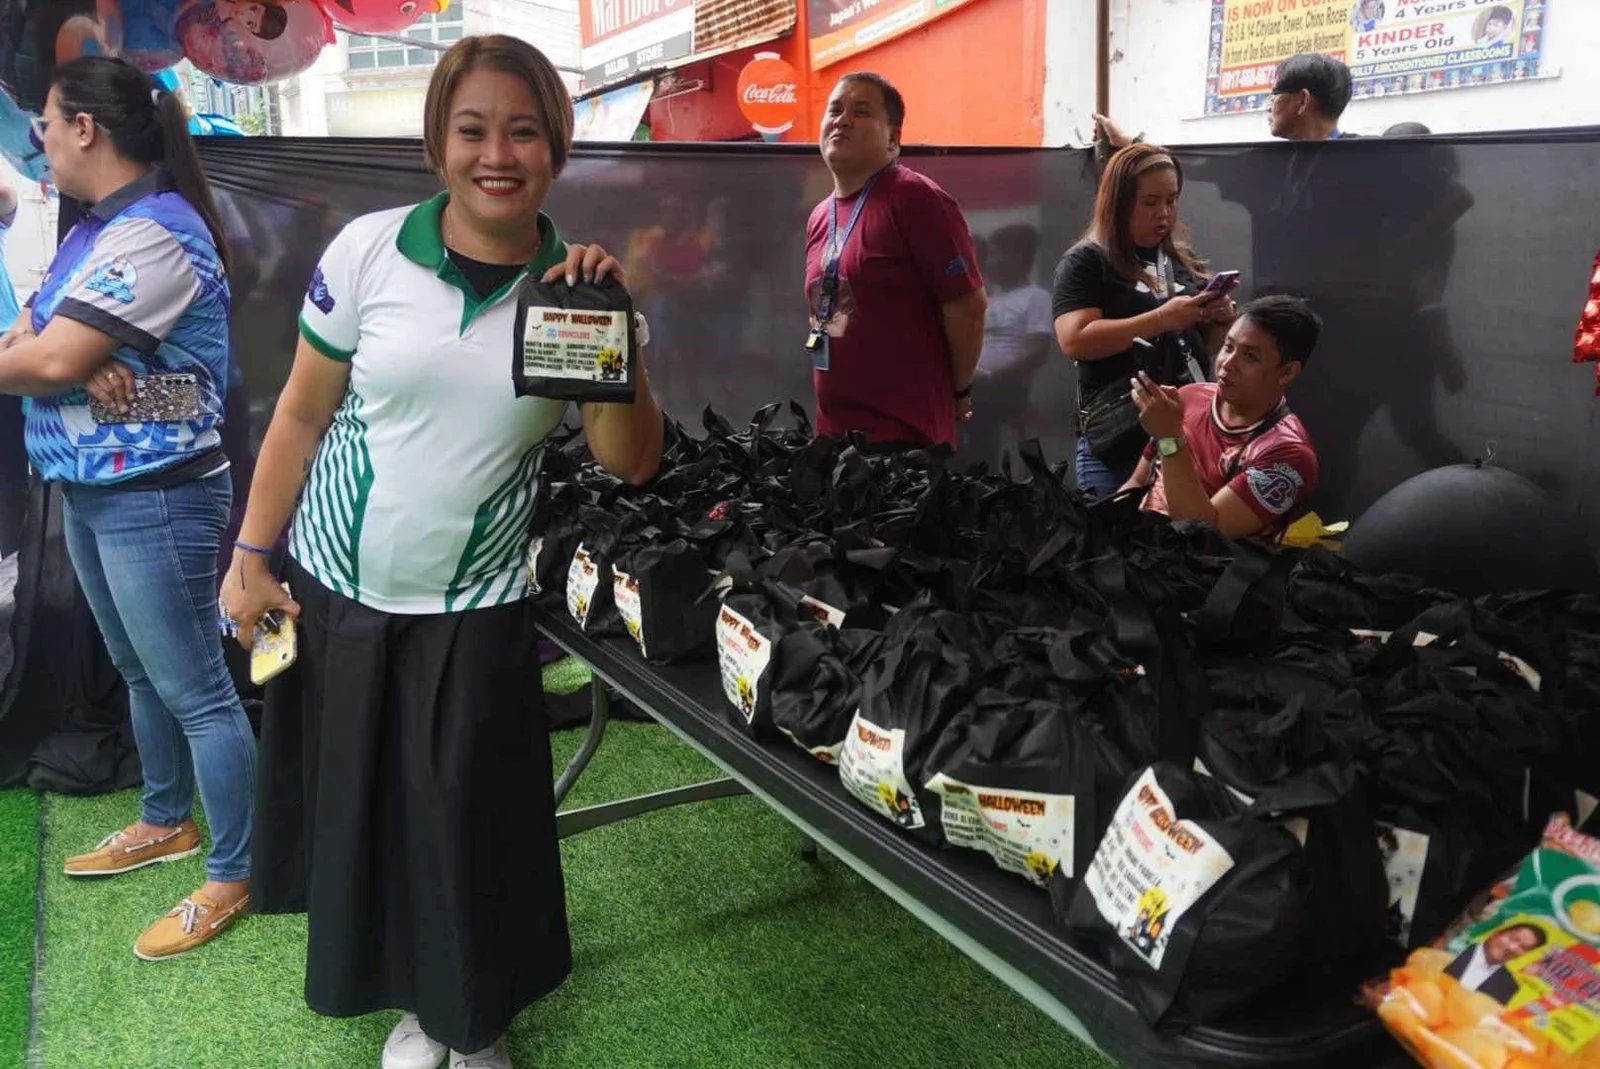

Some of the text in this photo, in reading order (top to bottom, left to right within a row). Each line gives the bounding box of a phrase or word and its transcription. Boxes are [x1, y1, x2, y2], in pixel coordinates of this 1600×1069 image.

[1228, 7, 1240, 22] IS
[1243, 1, 1274, 19] NOW
[1305, 10, 1325, 29] Chino
[1395, 9, 1406, 18] 4
[1414, 0, 1466, 15] Years
[1358, 22, 1445, 48] KINDER
[636, 43, 664, 65] STORE
[1356, 36, 1454, 60] 5 Years Old
[1447, 44, 1511, 64] CLASSROOMS
[743, 83, 797, 104] Coca-Cola
[543, 312, 613, 327] HAPPY HALLOWEEN
[978, 793, 1047, 817] HALLOWEEN
